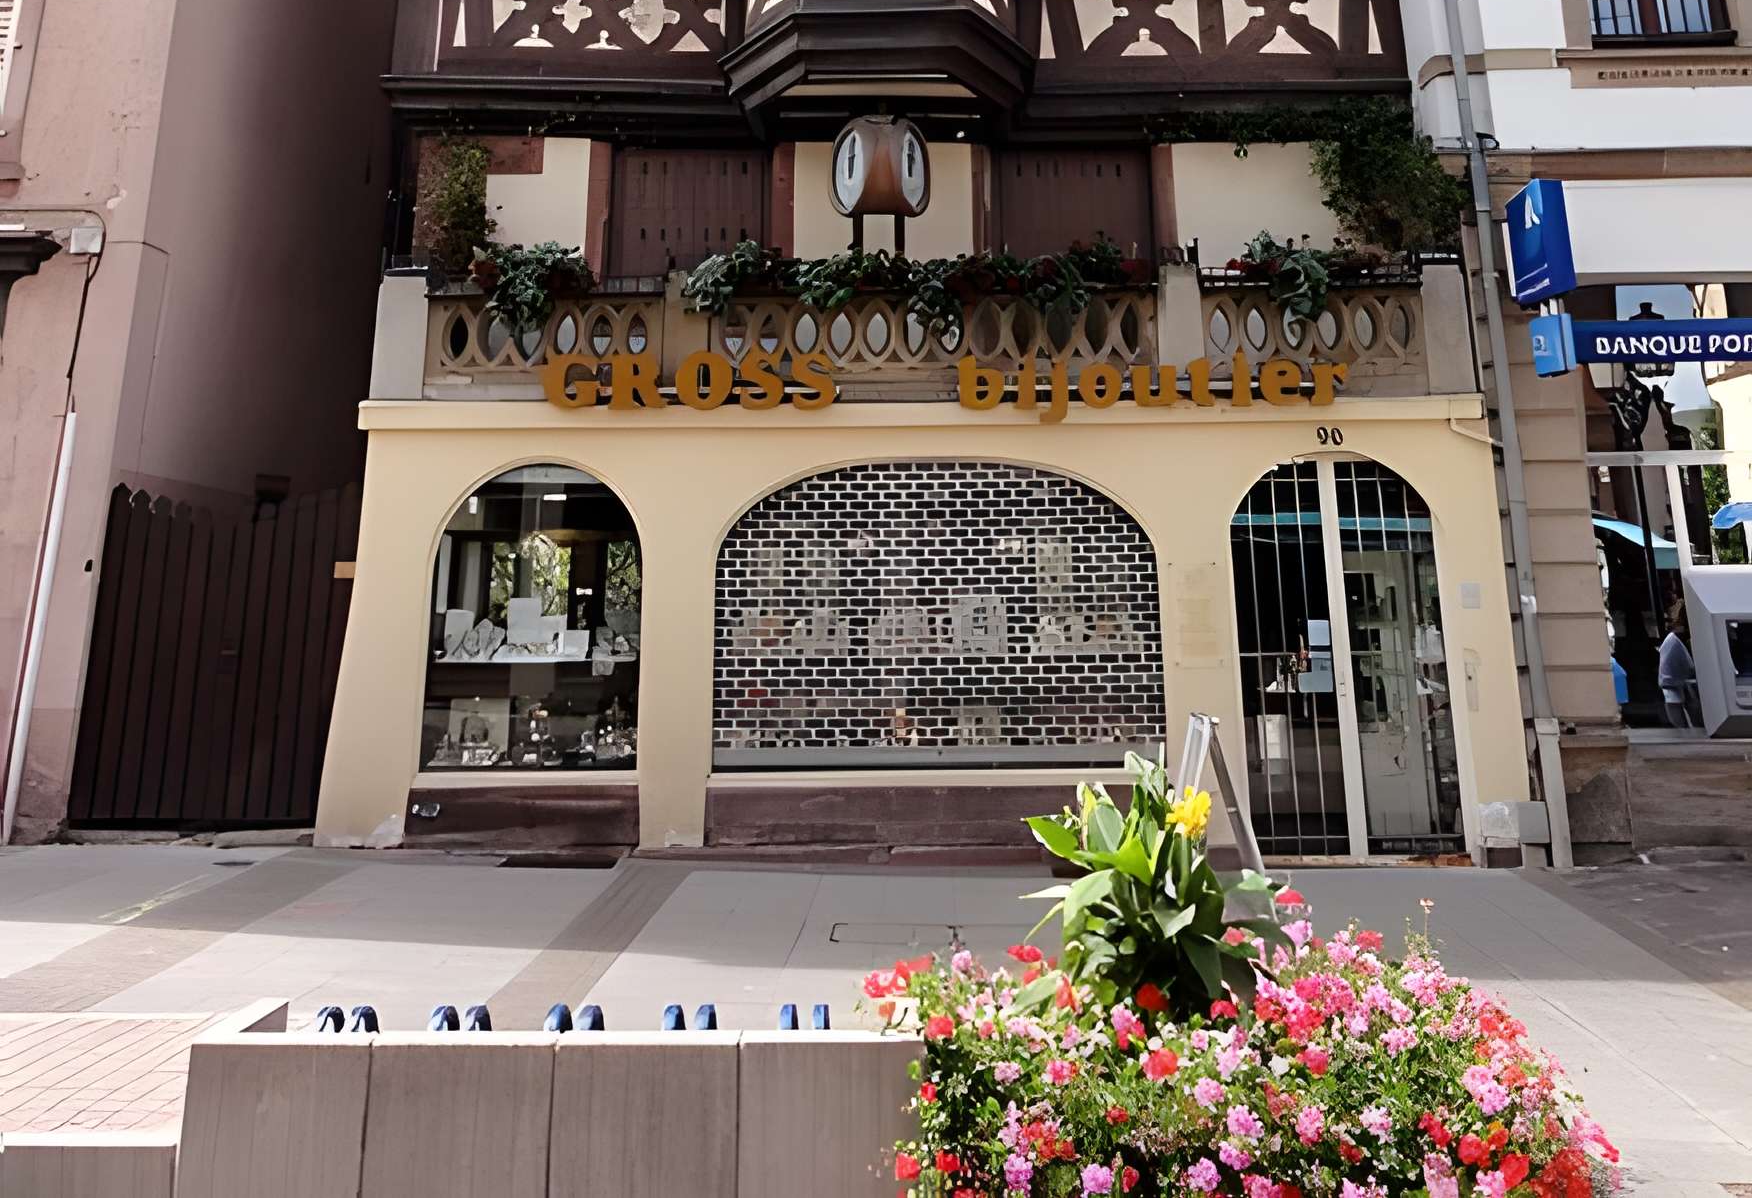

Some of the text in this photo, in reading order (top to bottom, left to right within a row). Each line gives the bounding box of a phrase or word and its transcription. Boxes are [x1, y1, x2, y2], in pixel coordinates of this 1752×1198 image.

[543, 351, 1349, 423] GROSS bijoutier
[1316, 426, 1344, 446] 90
